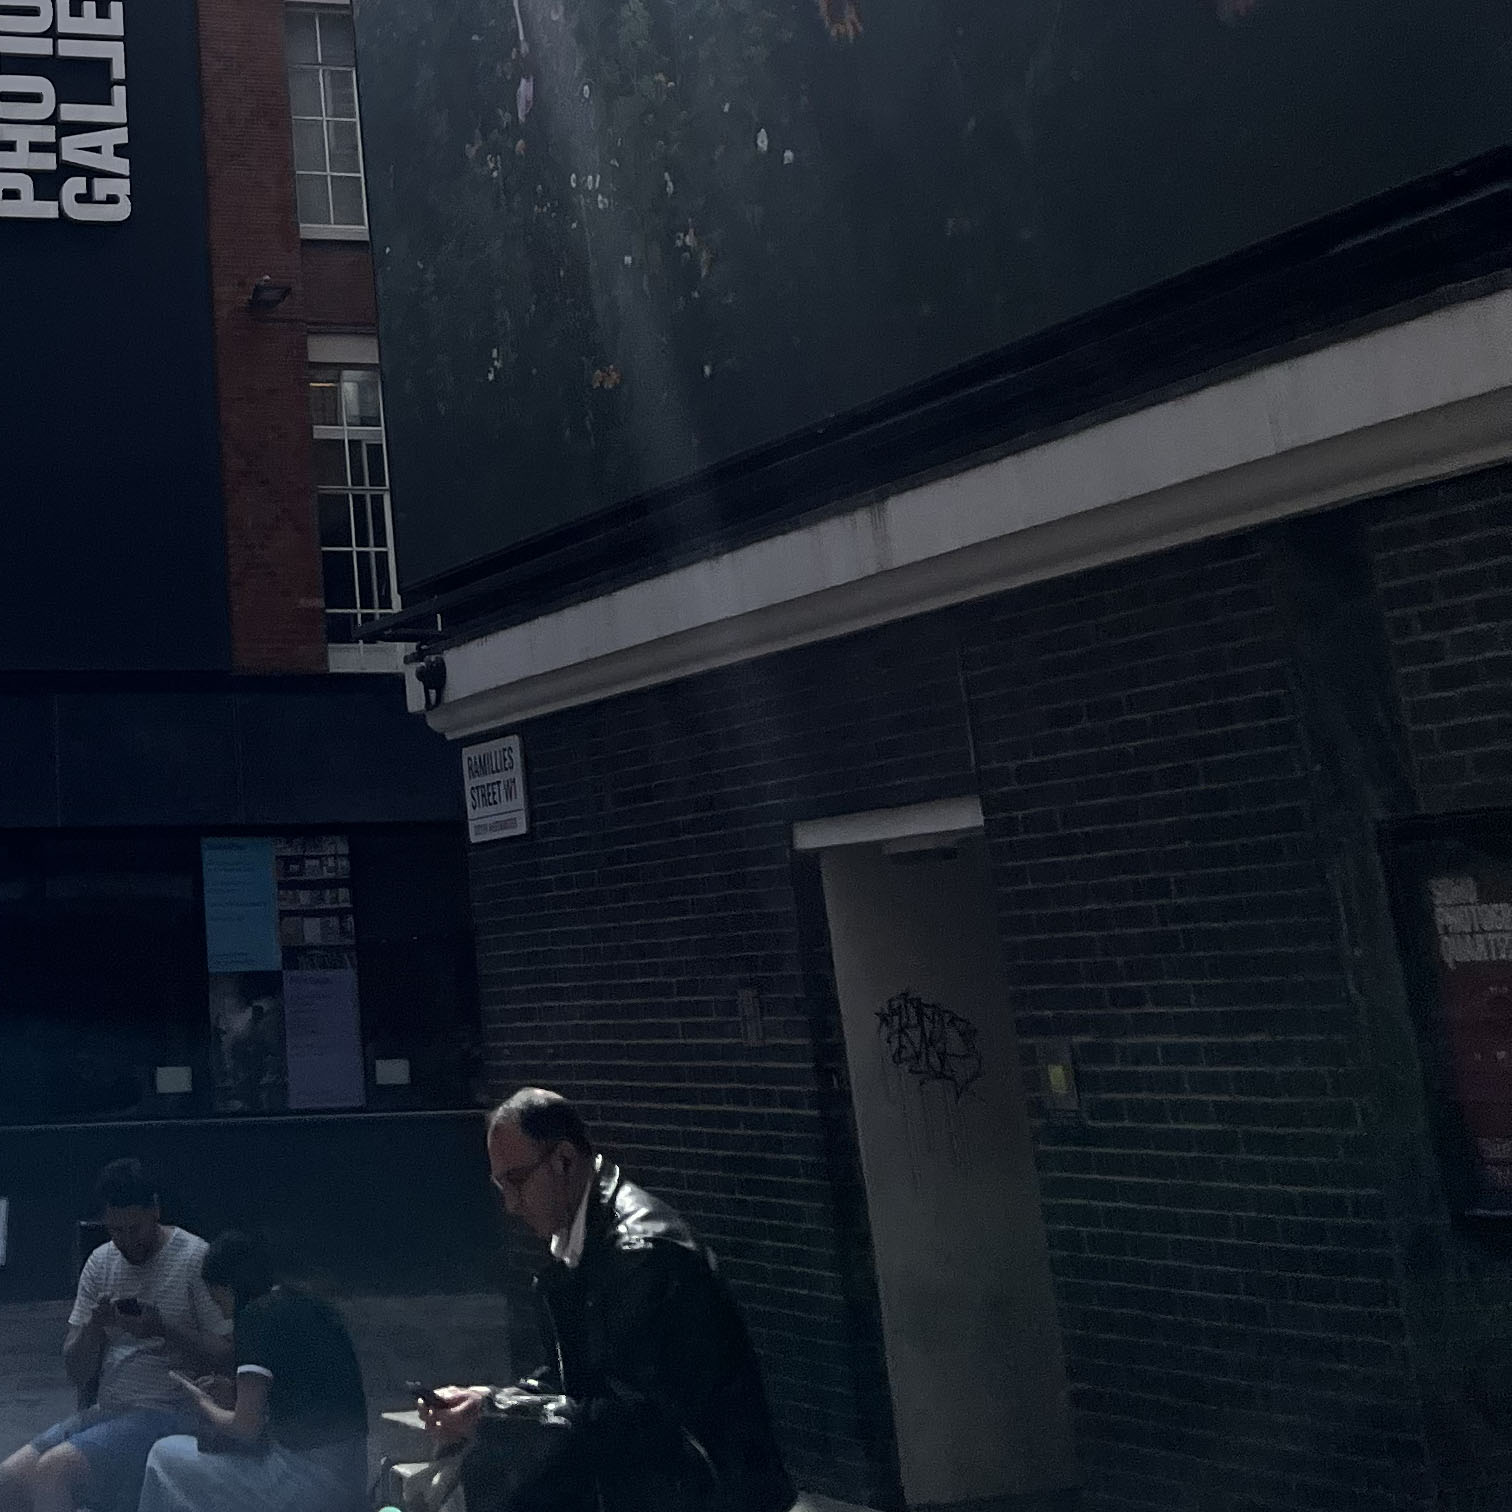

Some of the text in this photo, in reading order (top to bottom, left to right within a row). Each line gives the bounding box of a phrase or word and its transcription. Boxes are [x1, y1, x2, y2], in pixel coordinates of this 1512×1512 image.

[467, 746, 514, 780] RAMILLIES
[470, 777, 518, 810] STREET W1
